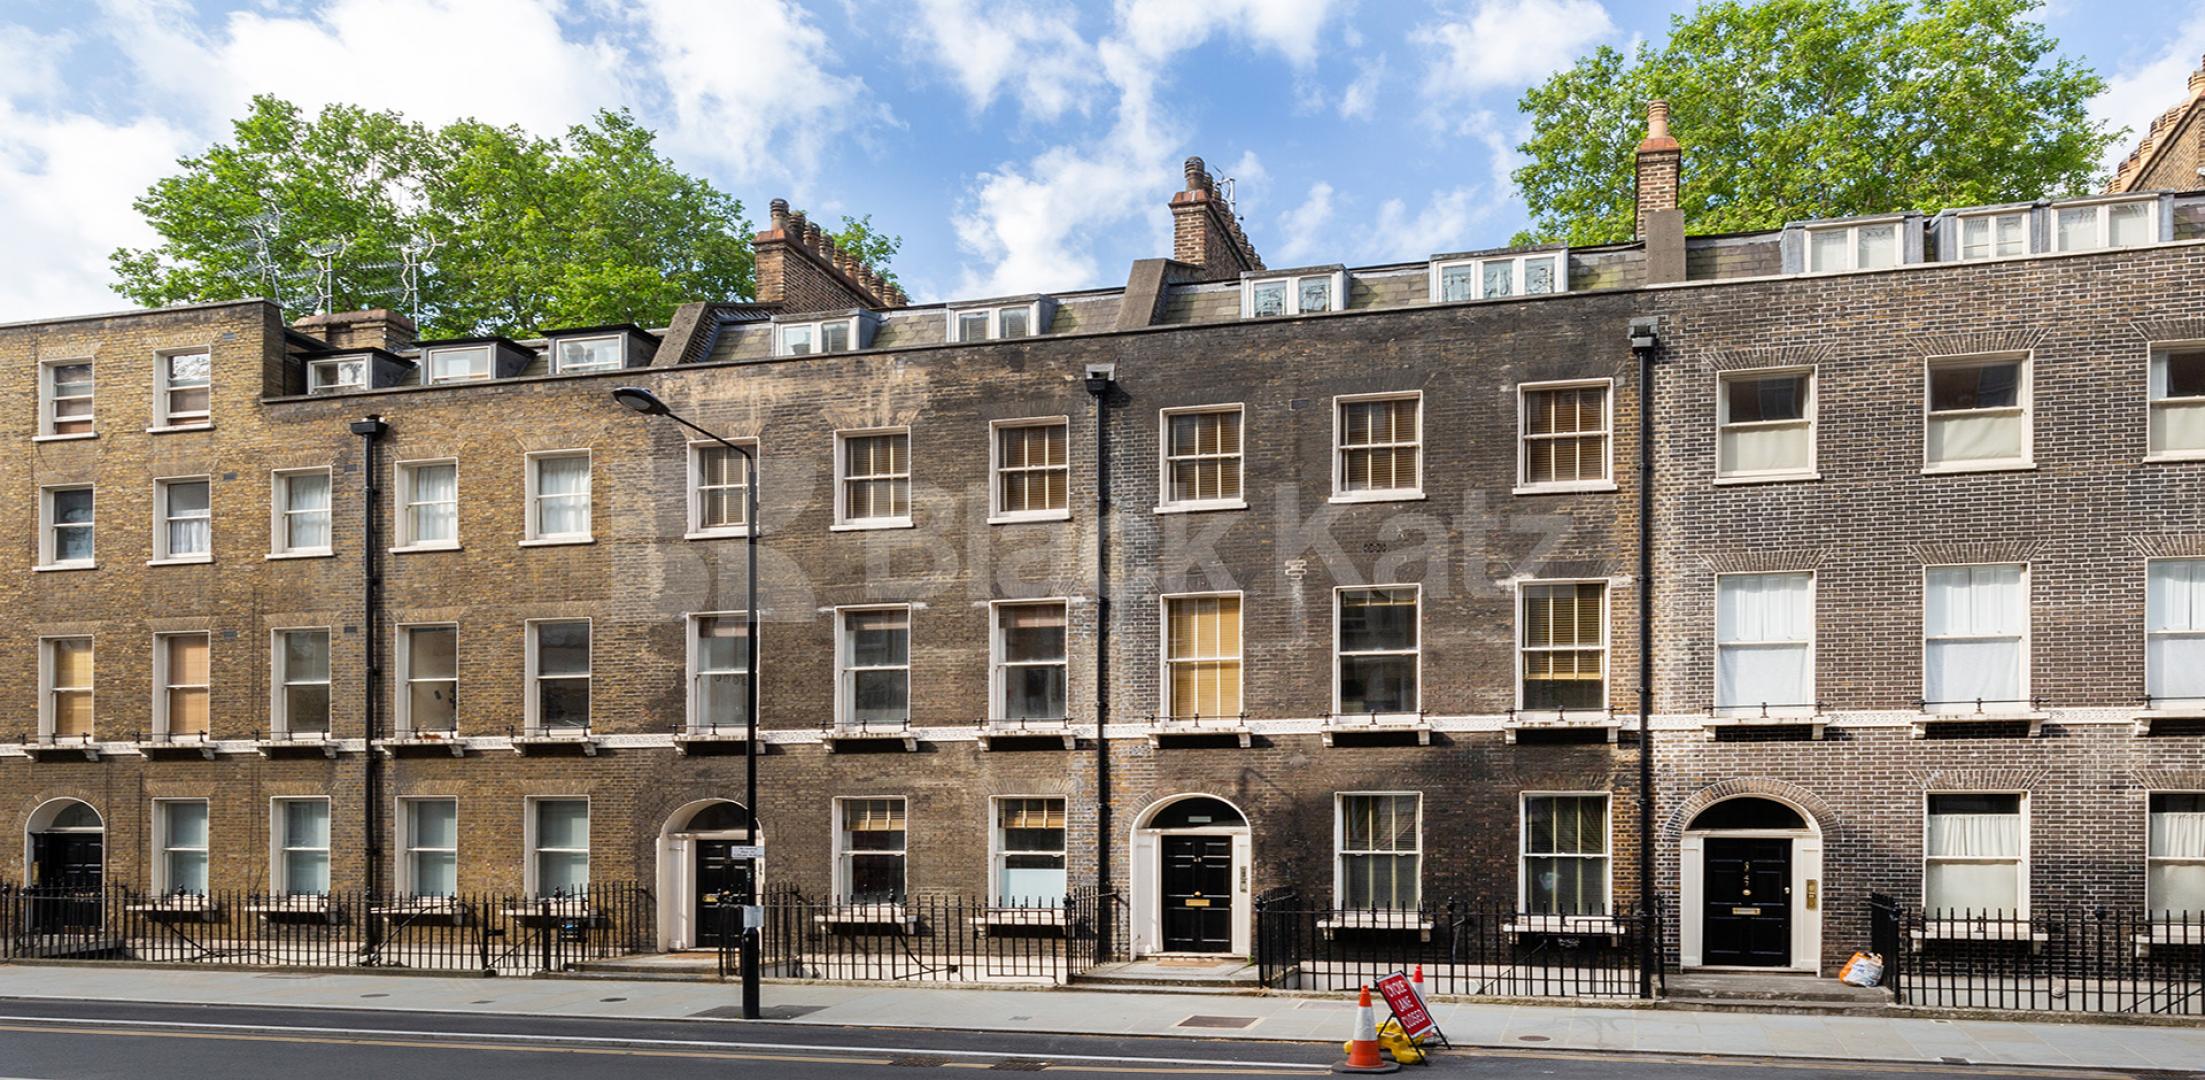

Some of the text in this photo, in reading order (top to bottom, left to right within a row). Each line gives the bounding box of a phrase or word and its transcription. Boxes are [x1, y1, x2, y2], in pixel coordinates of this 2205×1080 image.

[1385, 980, 1408, 997] CYCLE
[1394, 995, 1414, 1012] LANE
[1401, 1009, 1426, 1028] CLOSED
